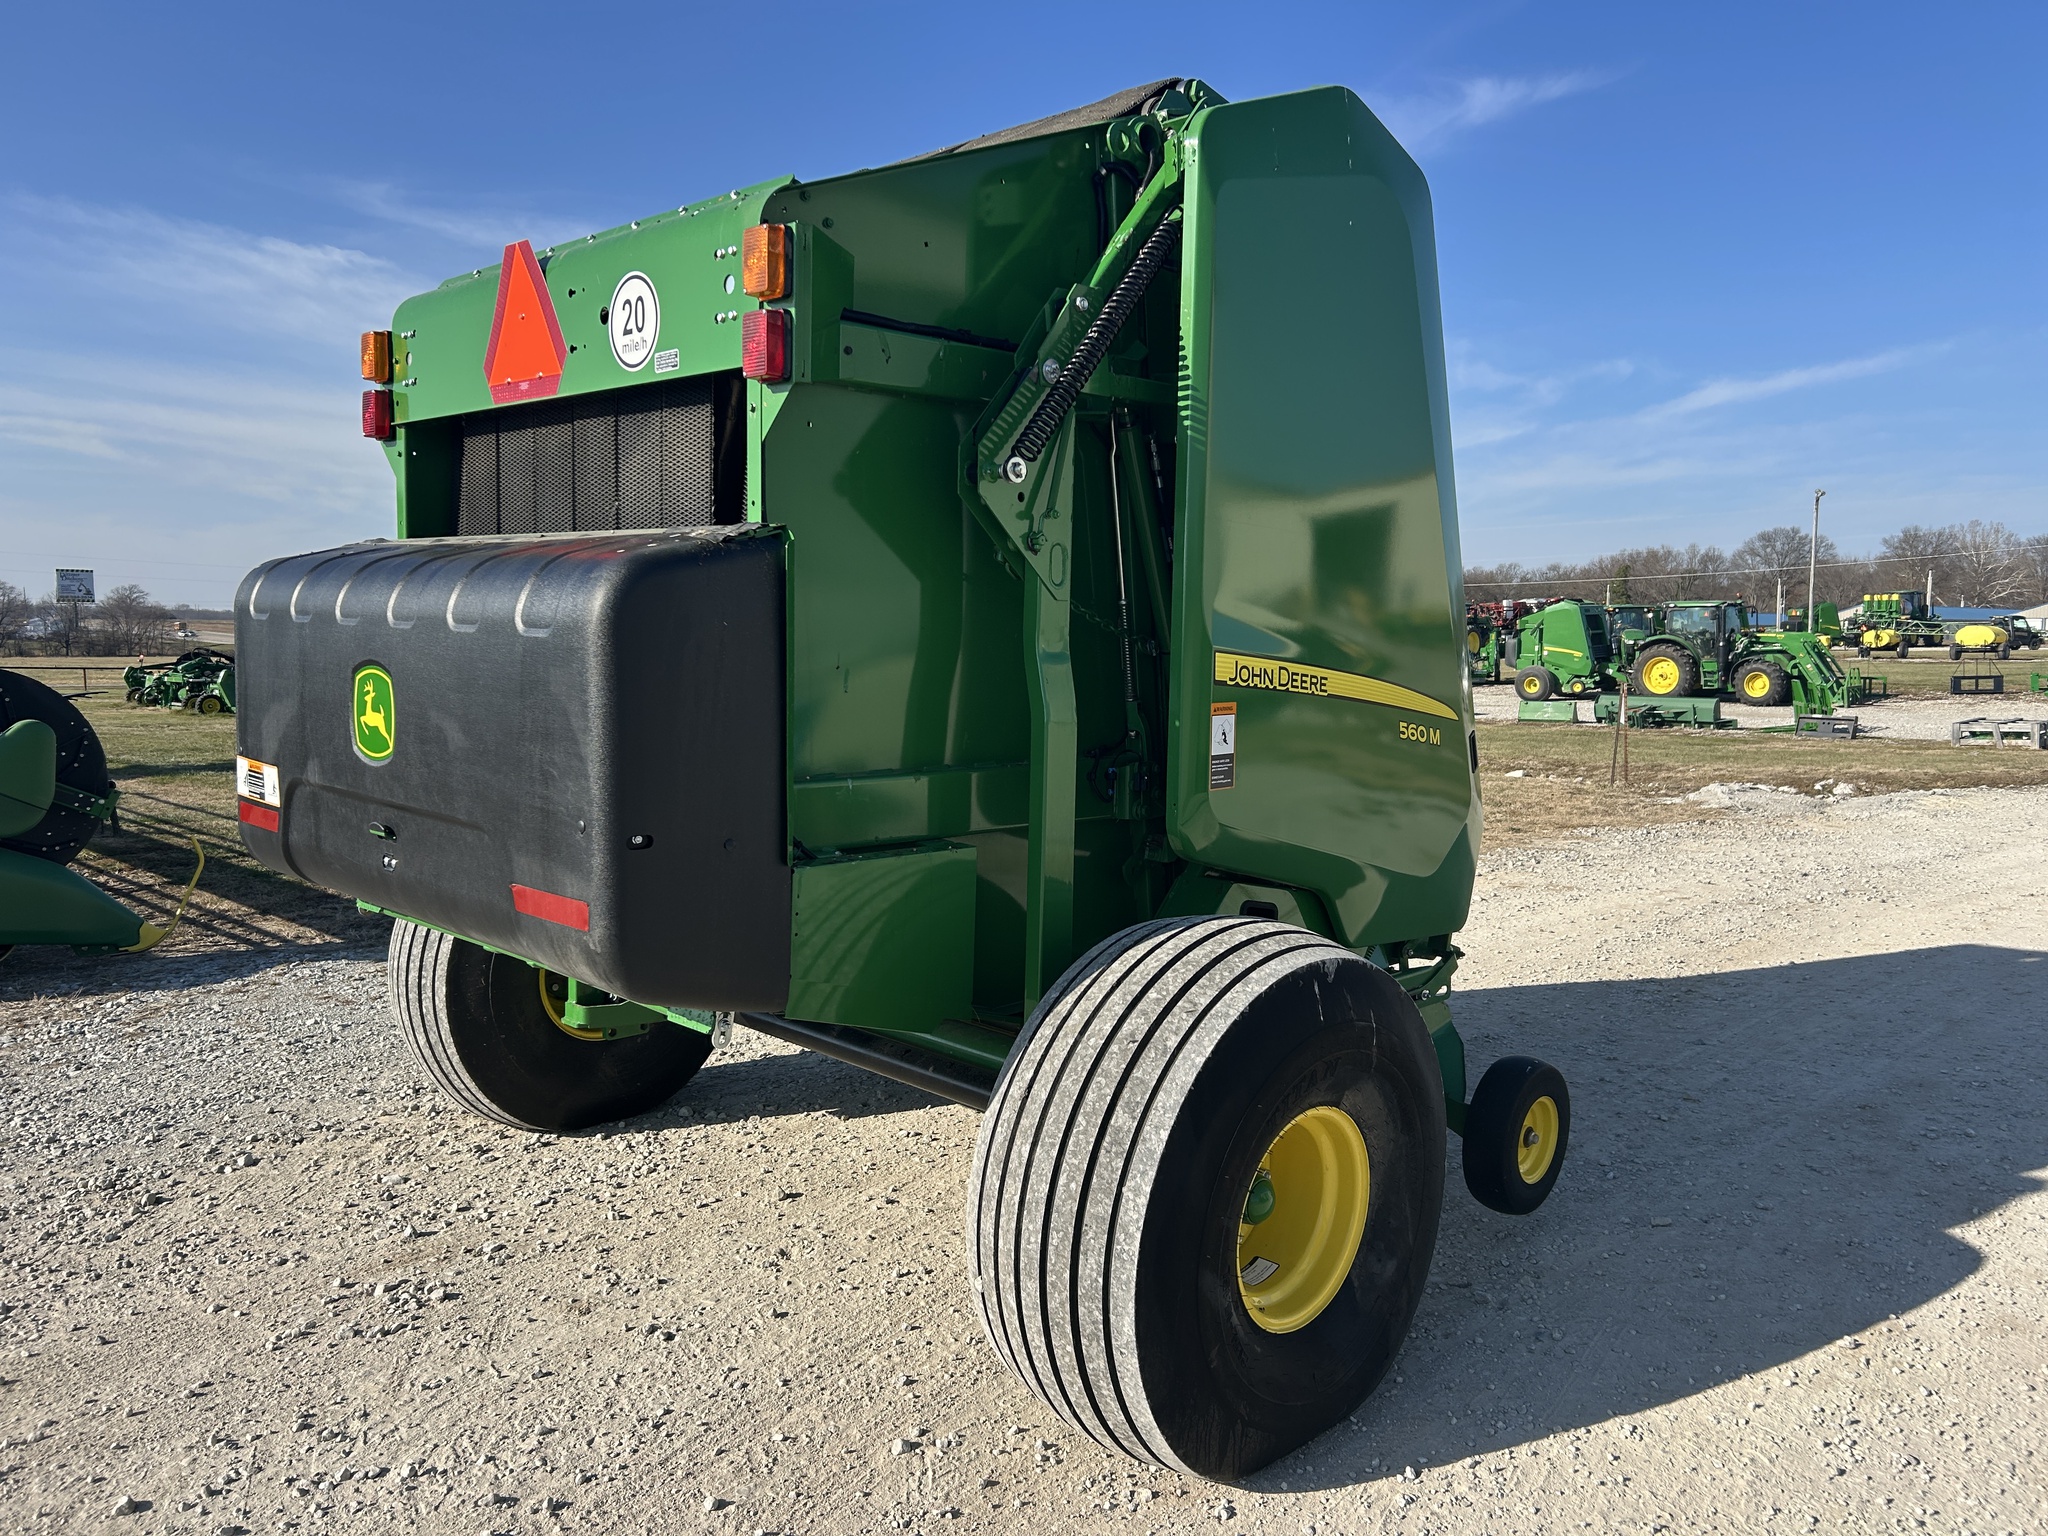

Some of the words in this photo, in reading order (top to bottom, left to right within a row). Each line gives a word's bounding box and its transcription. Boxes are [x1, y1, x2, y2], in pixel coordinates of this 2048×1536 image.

[622, 295, 645, 337] 20
[622, 337, 647, 354] mile/h
[1228, 660, 1275, 687] JOHN
[1277, 665, 1329, 694] DEERE
[1398, 720, 1427, 743] 560
[1429, 727, 1441, 746] M
